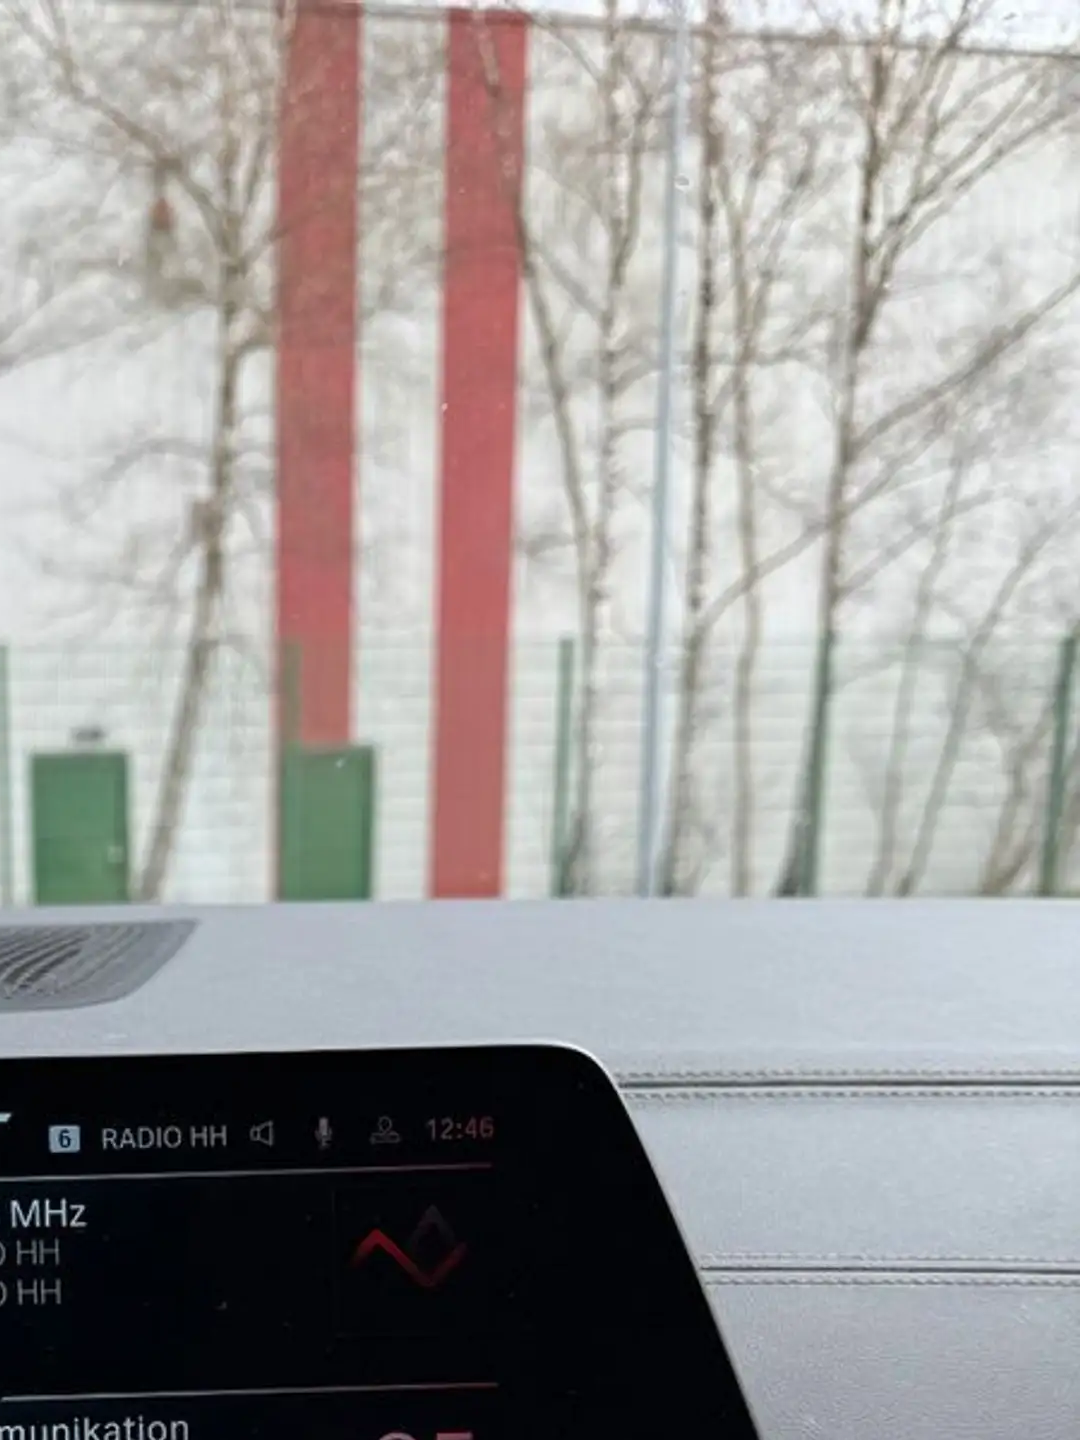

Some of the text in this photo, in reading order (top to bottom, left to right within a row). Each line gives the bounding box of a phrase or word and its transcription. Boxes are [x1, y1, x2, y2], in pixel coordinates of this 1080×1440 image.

[57, 1125, 228, 1150] 6 RADIO HH
[425, 1116, 495, 1141] 12:46
[9, 1199, 87, 1229] MHz
[16, 1239, 61, 1266] HH
[17, 1279, 62, 1305] HH
